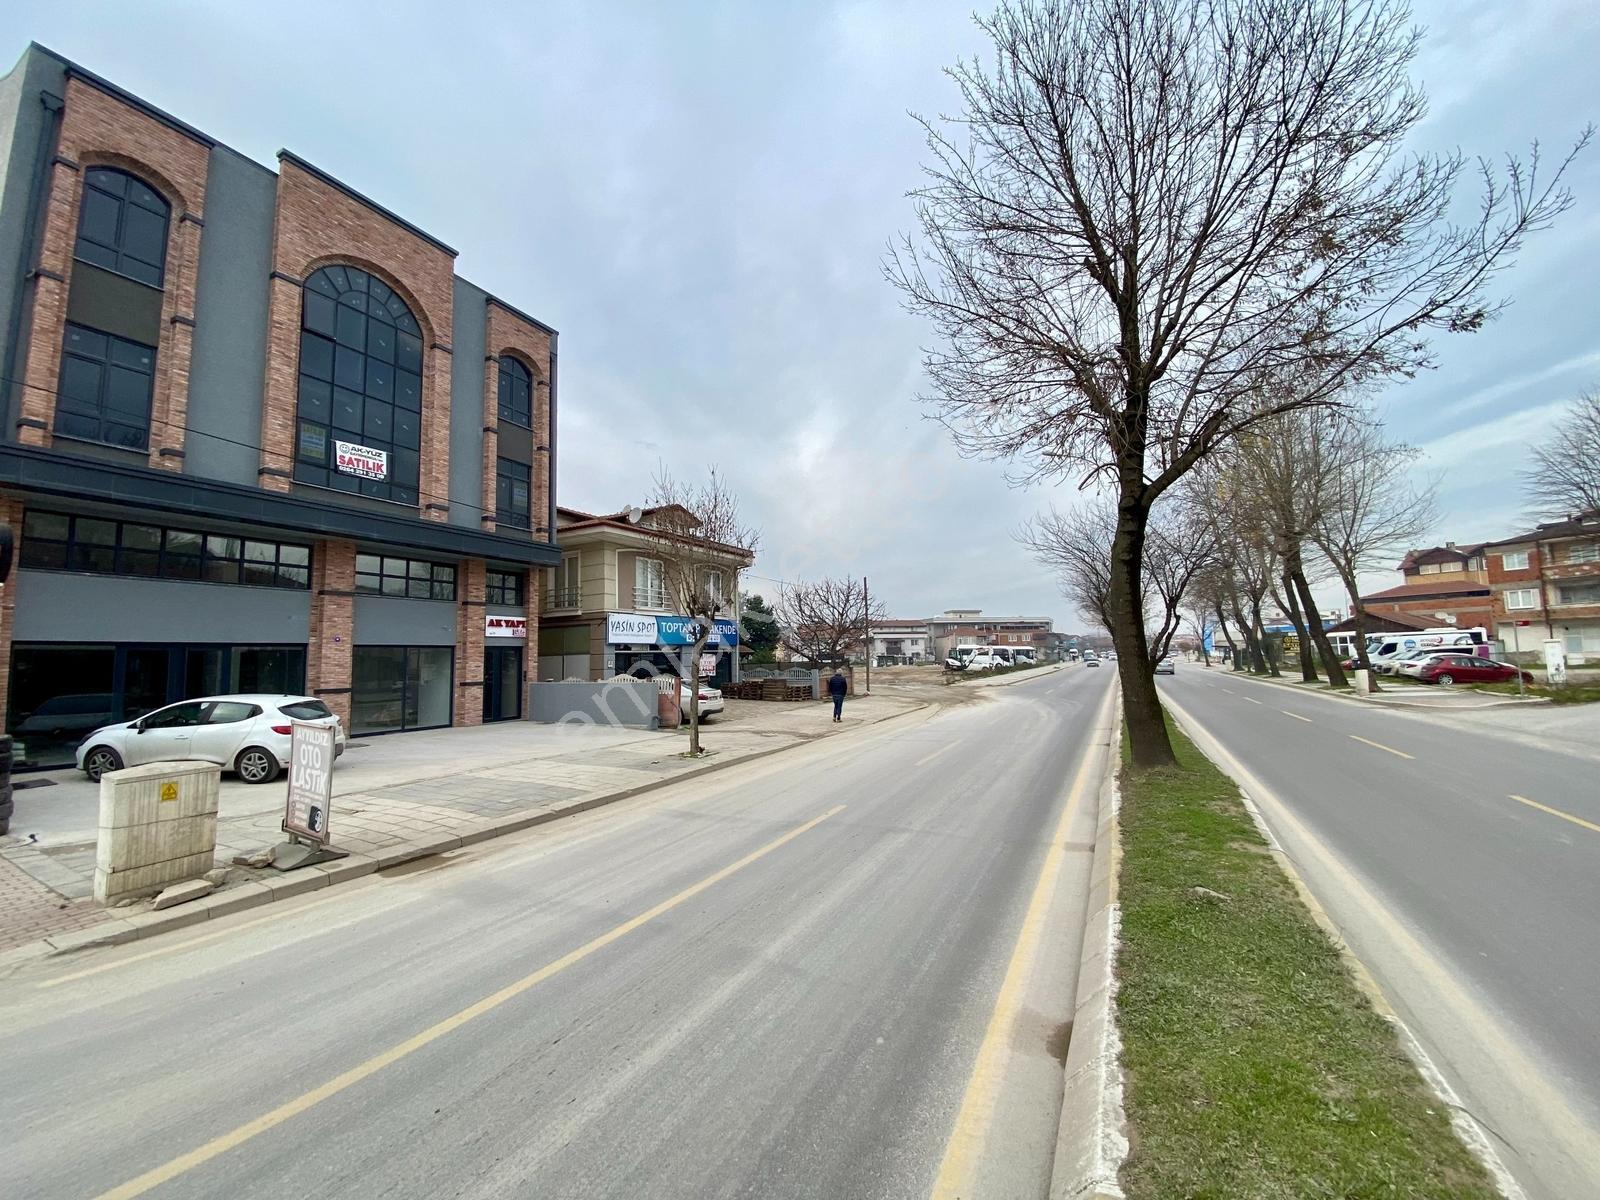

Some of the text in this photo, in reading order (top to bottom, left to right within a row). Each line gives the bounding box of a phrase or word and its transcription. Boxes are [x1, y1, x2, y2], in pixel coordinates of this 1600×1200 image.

[338, 454, 385, 474] SATILIK
[637, 621, 656, 633] SPOT
[695, 624, 737, 635] PAKENDE
[300, 743, 322, 769] OTO
